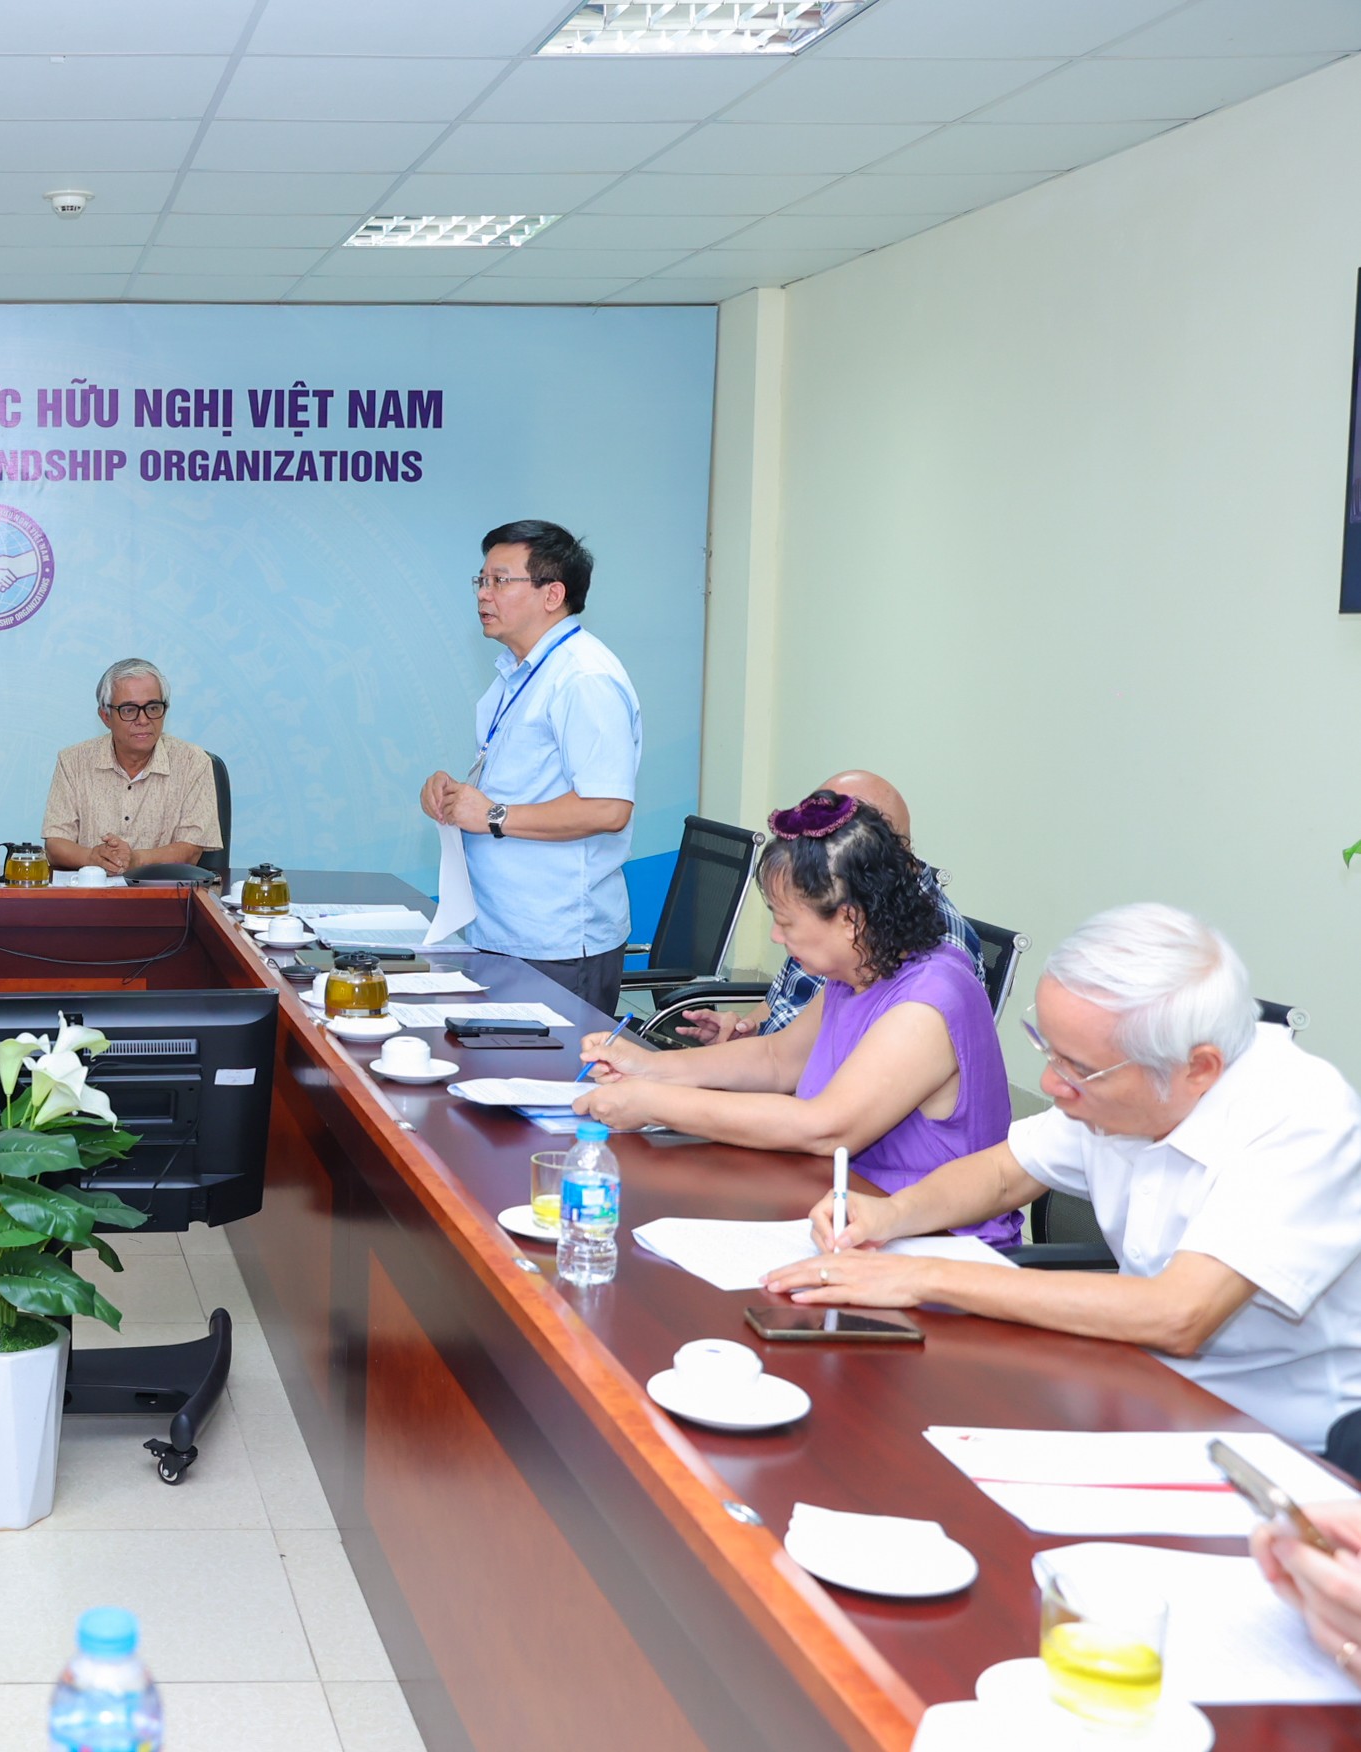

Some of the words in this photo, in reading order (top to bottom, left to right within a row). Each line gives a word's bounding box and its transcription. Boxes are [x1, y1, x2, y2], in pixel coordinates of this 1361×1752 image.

[37, 377, 119, 428] HỮU
[134, 388, 233, 437] NGHỊ
[248, 380, 334, 437] VIỆT
[348, 389, 443, 429] NAM
[140, 449, 423, 483] ORGANIZATIONS
[14, 577, 50, 621] ORGANIZATIONS
